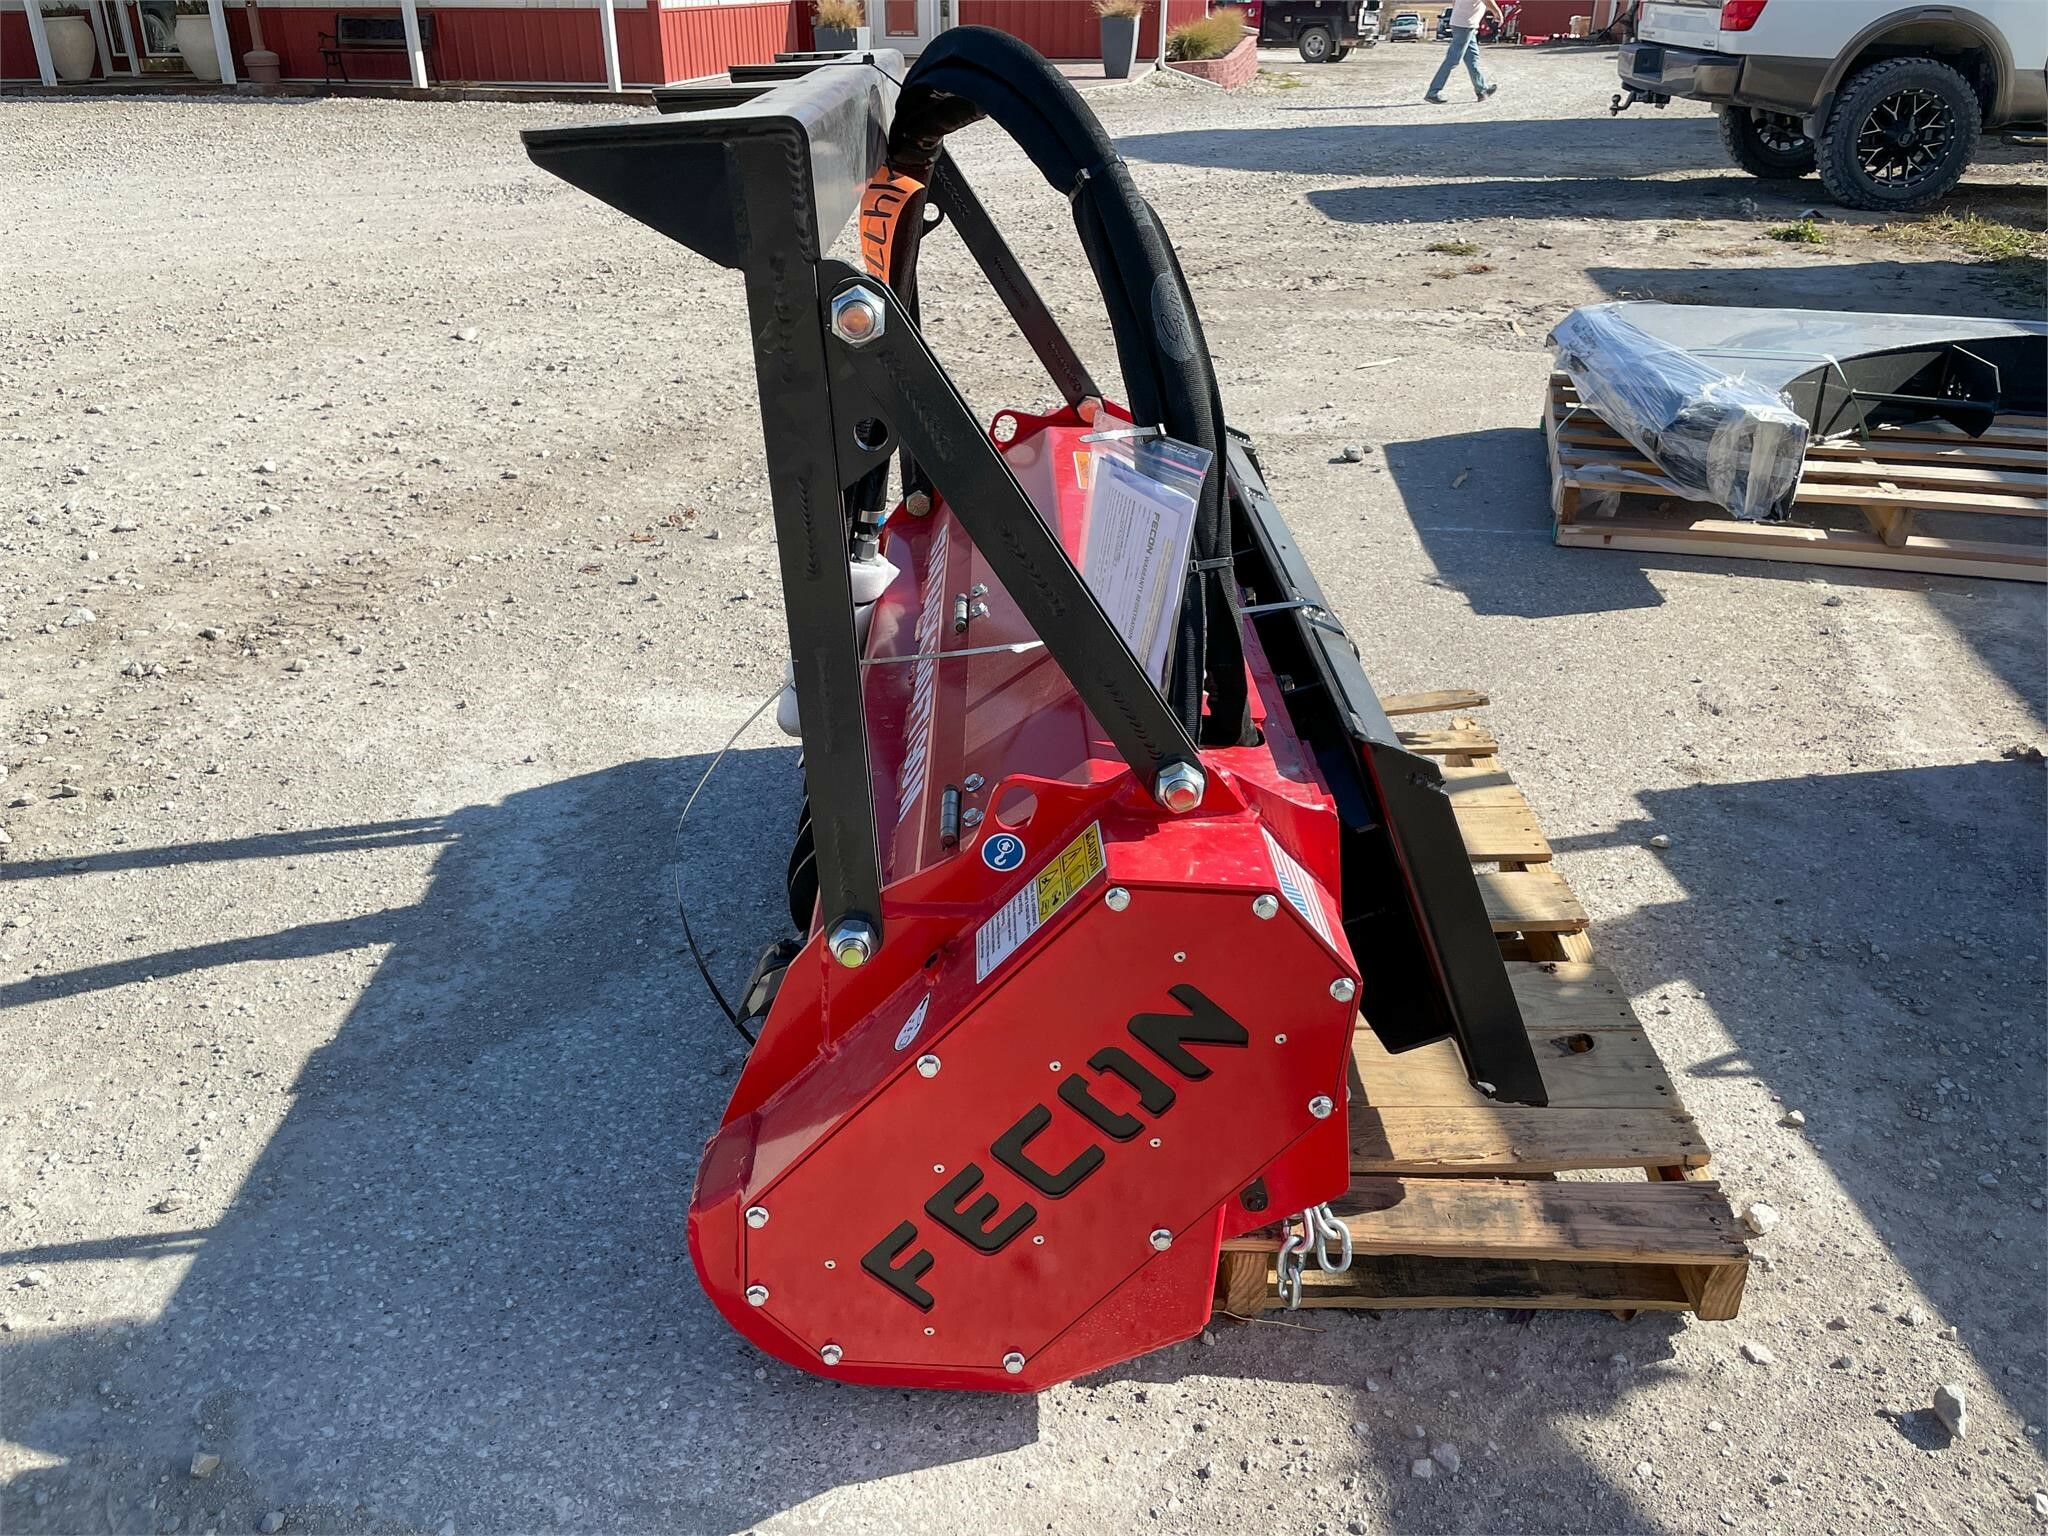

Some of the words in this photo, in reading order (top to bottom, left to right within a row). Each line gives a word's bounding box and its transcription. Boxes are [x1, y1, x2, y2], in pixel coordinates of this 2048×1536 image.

[862, 183, 907, 279] 1477
[925, 523, 948, 590] STAY
[1144, 511, 1160, 555] FECON
[1136, 556, 1152, 596] WARRANTY
[918, 573, 943, 656] BACK
[1086, 834, 1100, 873] CAUTION
[860, 983, 1249, 1314] FECON
